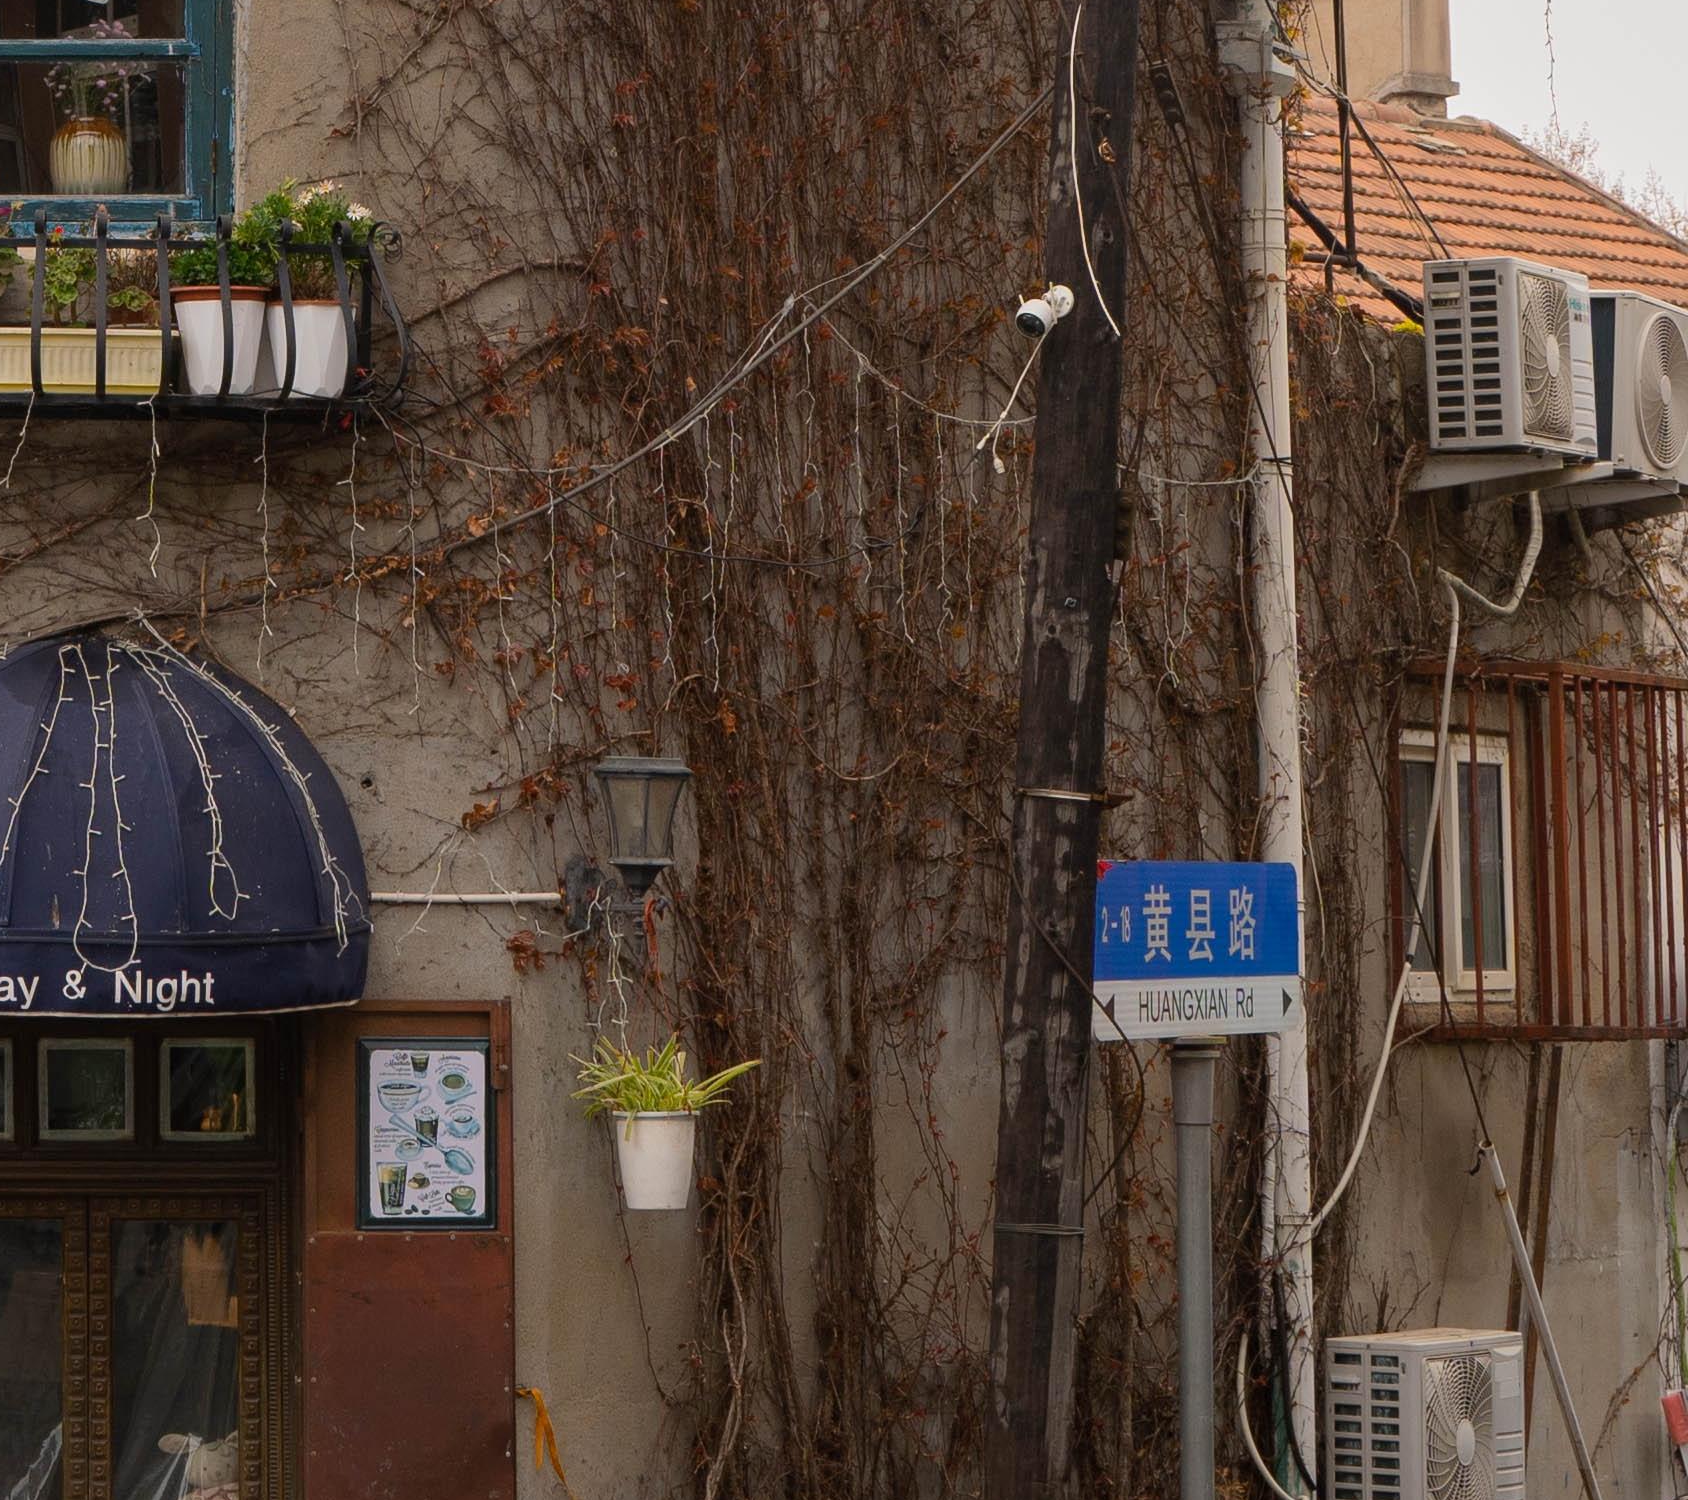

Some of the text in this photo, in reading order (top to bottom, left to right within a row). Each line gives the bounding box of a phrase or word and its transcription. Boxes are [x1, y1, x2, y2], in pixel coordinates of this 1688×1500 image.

[1101, 884, 1257, 963] 2-18 黄县路
[61, 968, 87, 1001] &
[113, 968, 216, 1012] Night
[1138, 987, 1255, 1023] HUANGXIAN Rd
